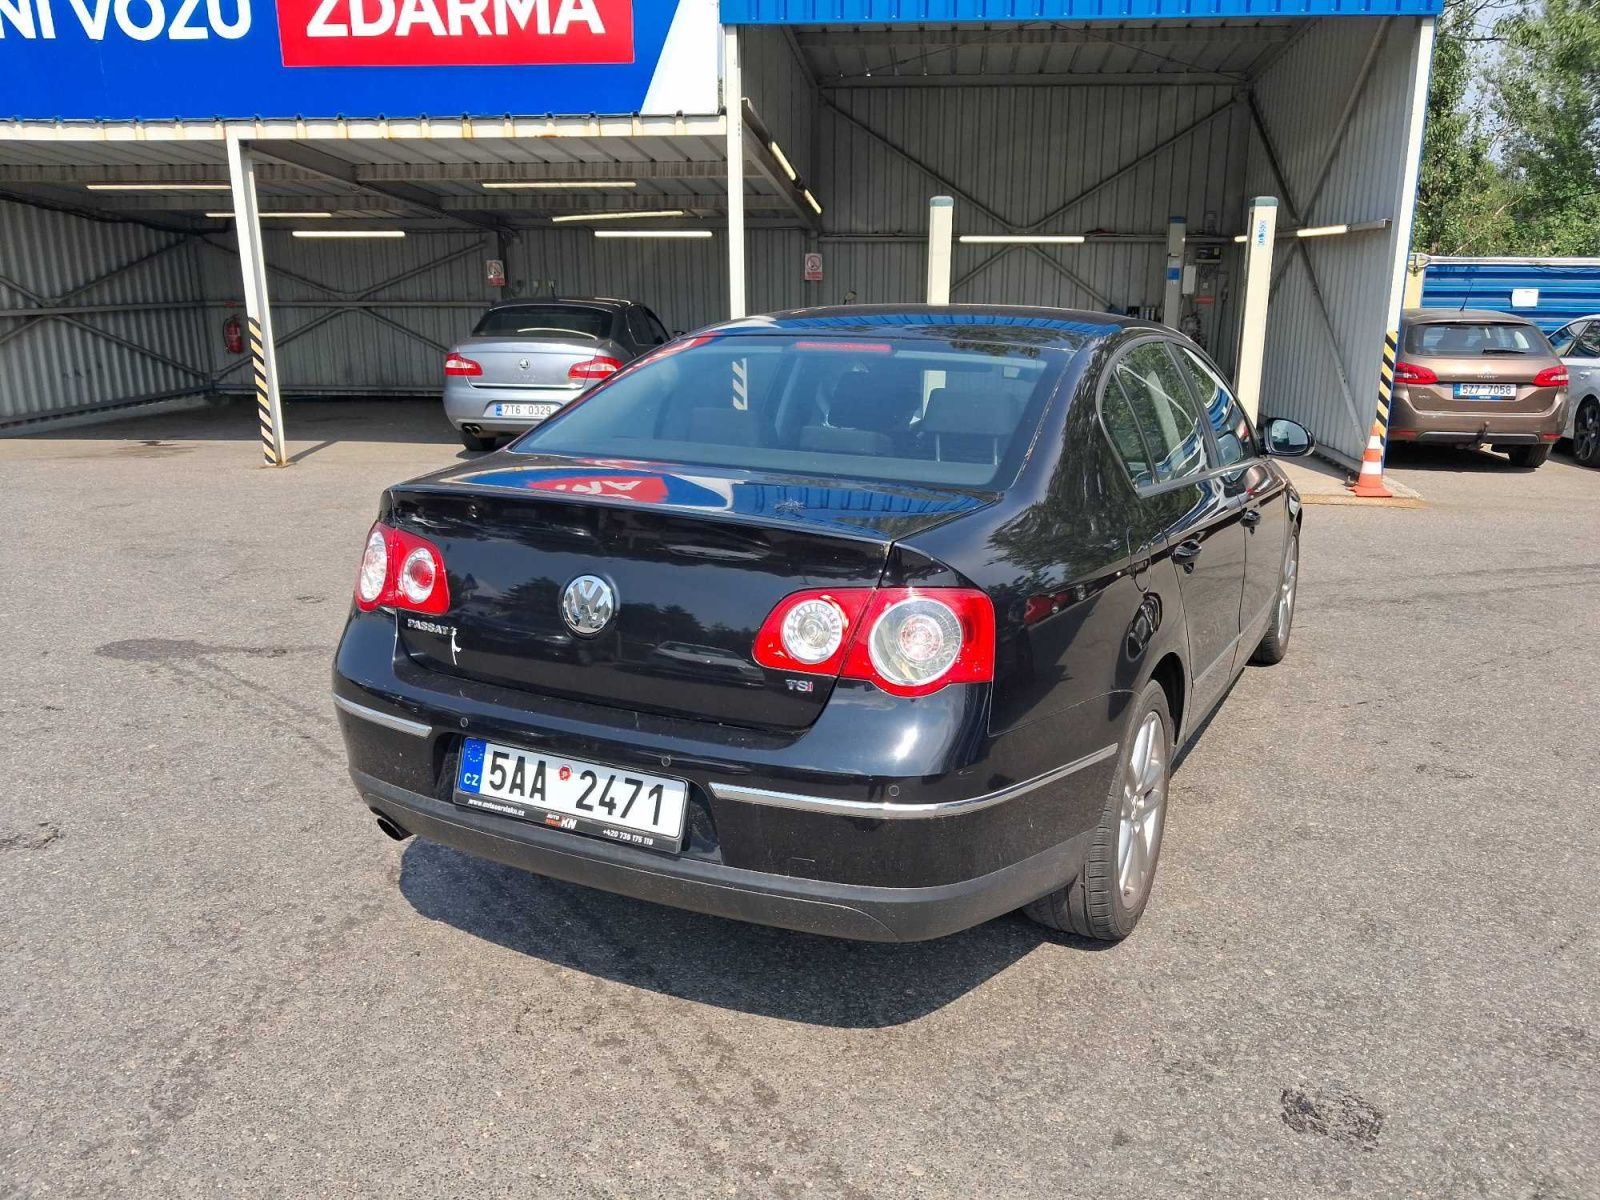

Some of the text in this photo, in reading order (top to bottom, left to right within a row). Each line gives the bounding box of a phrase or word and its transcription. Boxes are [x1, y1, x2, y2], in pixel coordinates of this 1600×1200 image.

[306, 0, 606, 37] ZDARMA
[1488, 384, 1512, 395] 7058
[504, 404, 552, 416] 7T6 0329
[407, 618, 449, 635] PASSAT
[463, 772, 480, 787] CZ
[489, 750, 665, 826] 5AA 2471
